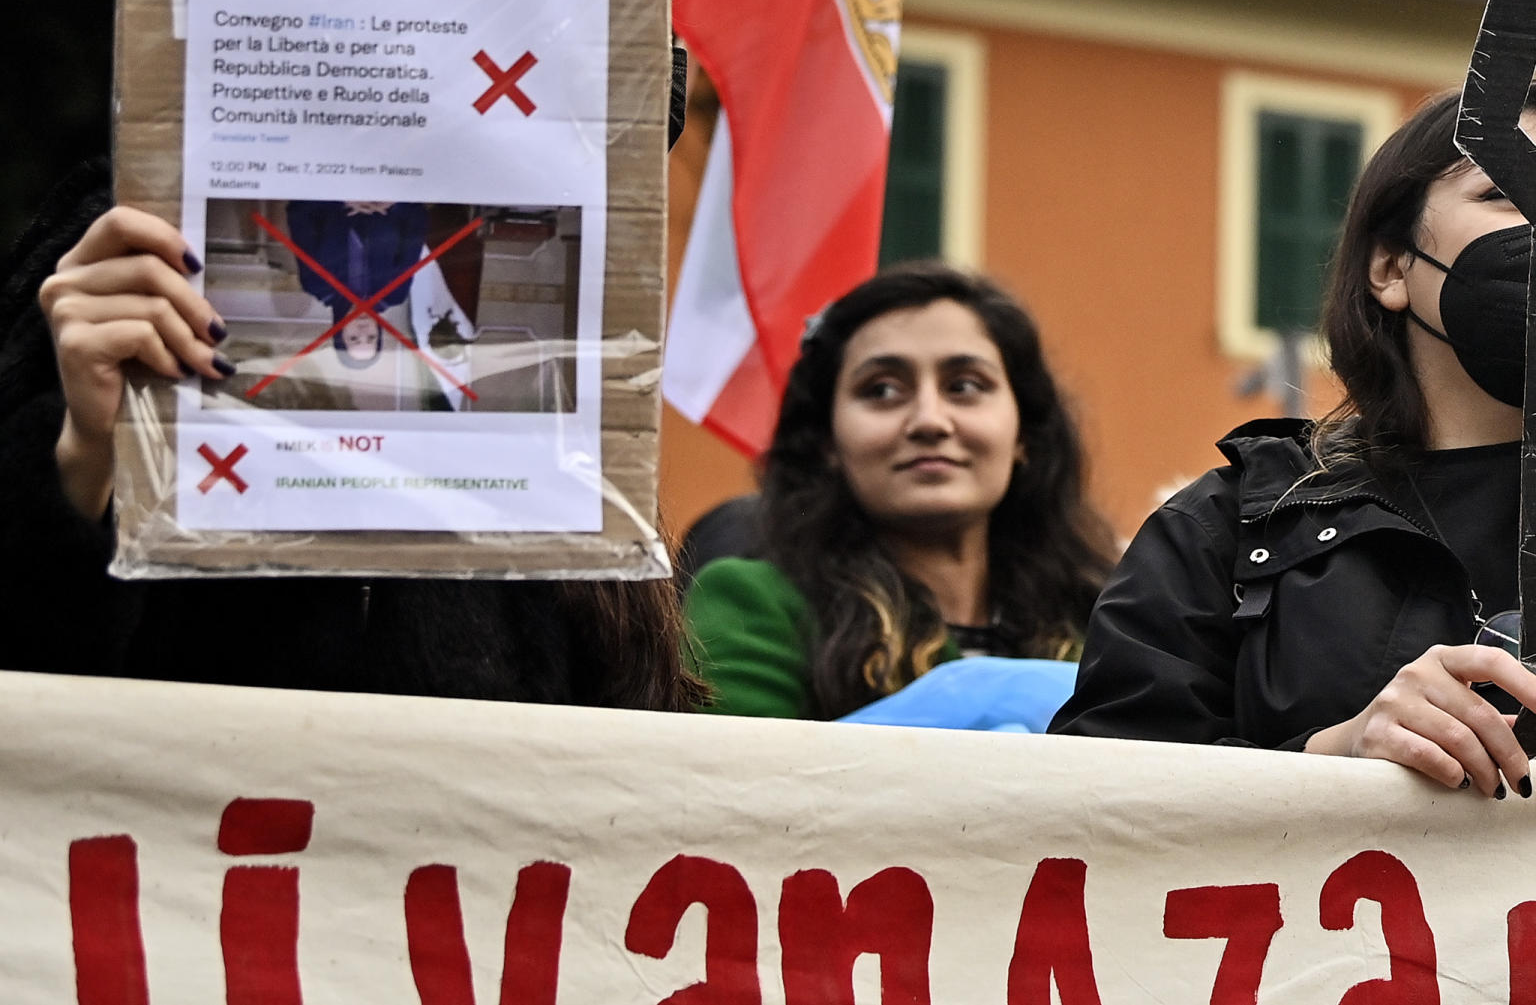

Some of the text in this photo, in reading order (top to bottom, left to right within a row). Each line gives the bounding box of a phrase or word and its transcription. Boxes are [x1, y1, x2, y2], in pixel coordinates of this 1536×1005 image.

[213, 11, 304, 32] Convegno
[307, 14, 355, 30] #Iran
[370, 17, 392, 32] Le
[396, 19, 469, 37] proteste
[213, 36, 416, 58] per la Libertà e per una
[213, 59, 435, 81] Repubblica Democratica.
[212, 83, 430, 104] Prospettive e Ruolo della
[211, 106, 428, 128] Comunità Internazionale
[339, 435, 385, 453] NOT
[275, 476, 529, 491] IRANIAN PEOPLE REPRESENTATIVE
